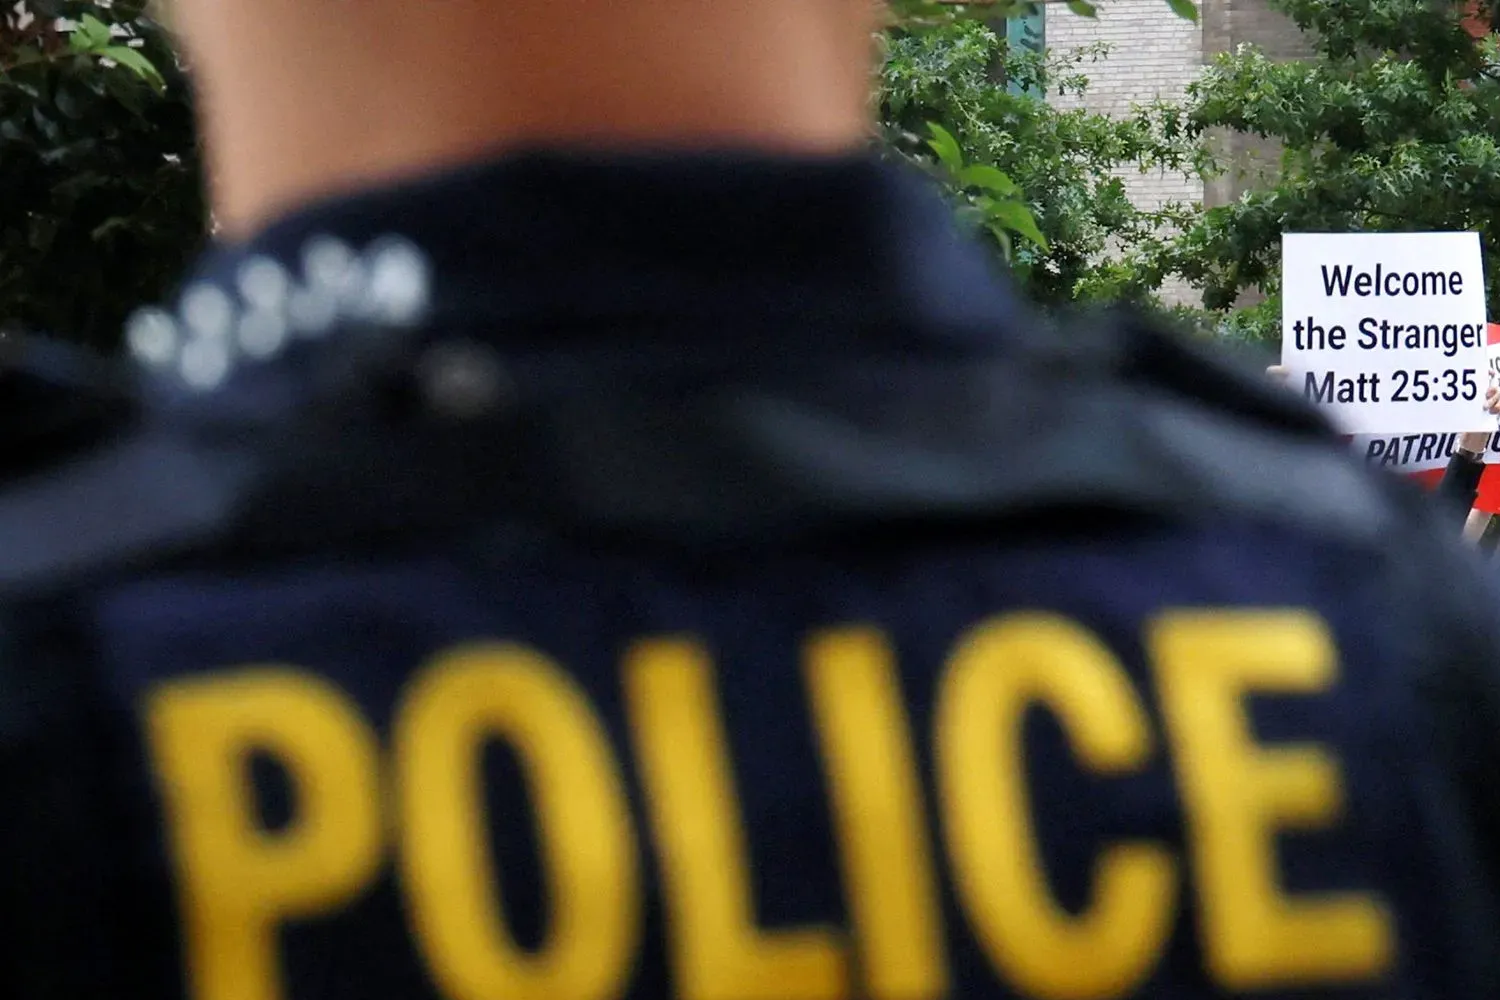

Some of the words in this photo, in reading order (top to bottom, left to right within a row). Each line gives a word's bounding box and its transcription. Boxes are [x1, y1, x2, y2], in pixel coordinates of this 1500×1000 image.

[1321, 263, 1463, 297] Welcome
[1293, 316, 1346, 350] the
[1357, 317, 1483, 357] Stranger
[1304, 371, 1380, 403] Matt
[1391, 369, 1478, 401] 25:35
